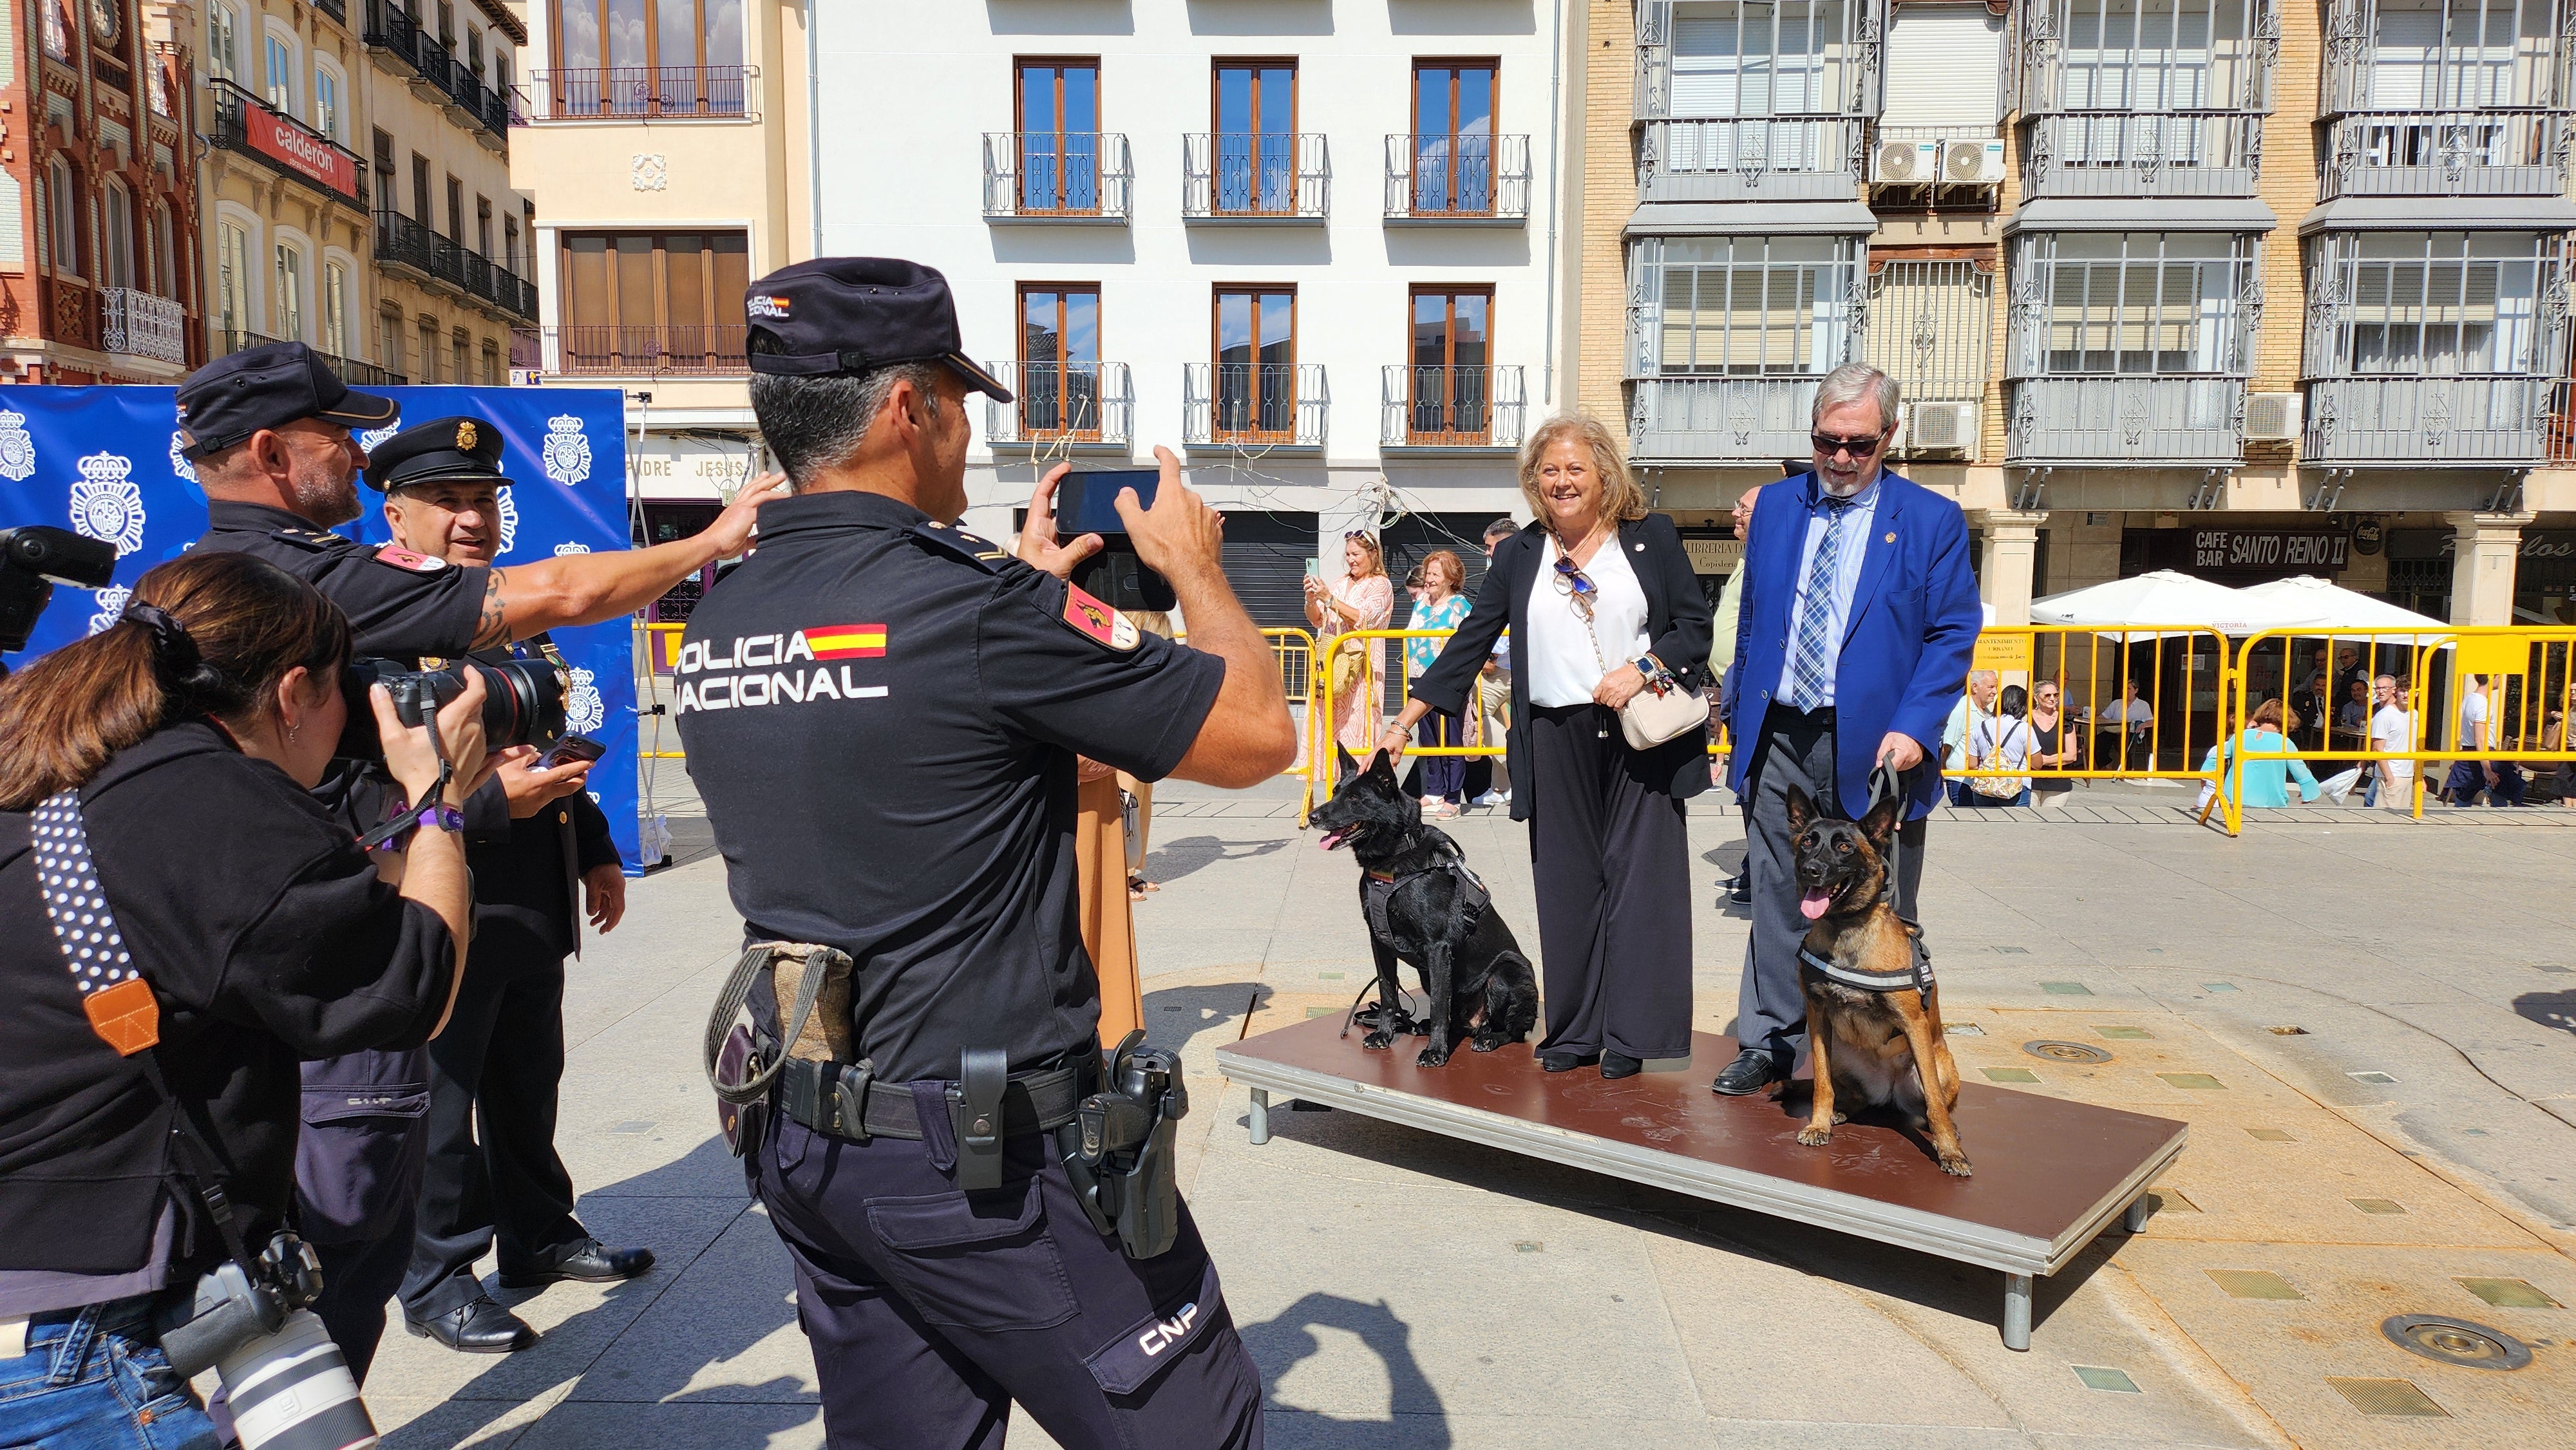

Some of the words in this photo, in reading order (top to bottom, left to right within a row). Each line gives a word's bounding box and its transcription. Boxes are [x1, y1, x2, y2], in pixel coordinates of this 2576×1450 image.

[696, 460, 743, 476] JESUS
[2196, 532, 2228, 548] CAFE
[2230, 535, 2280, 564] SANTO
[2284, 536, 2329, 564] REINO
[2331, 537, 2347, 564] II
[2196, 551, 2224, 566] BAR
[1139, 1303, 1197, 1356] CNP
